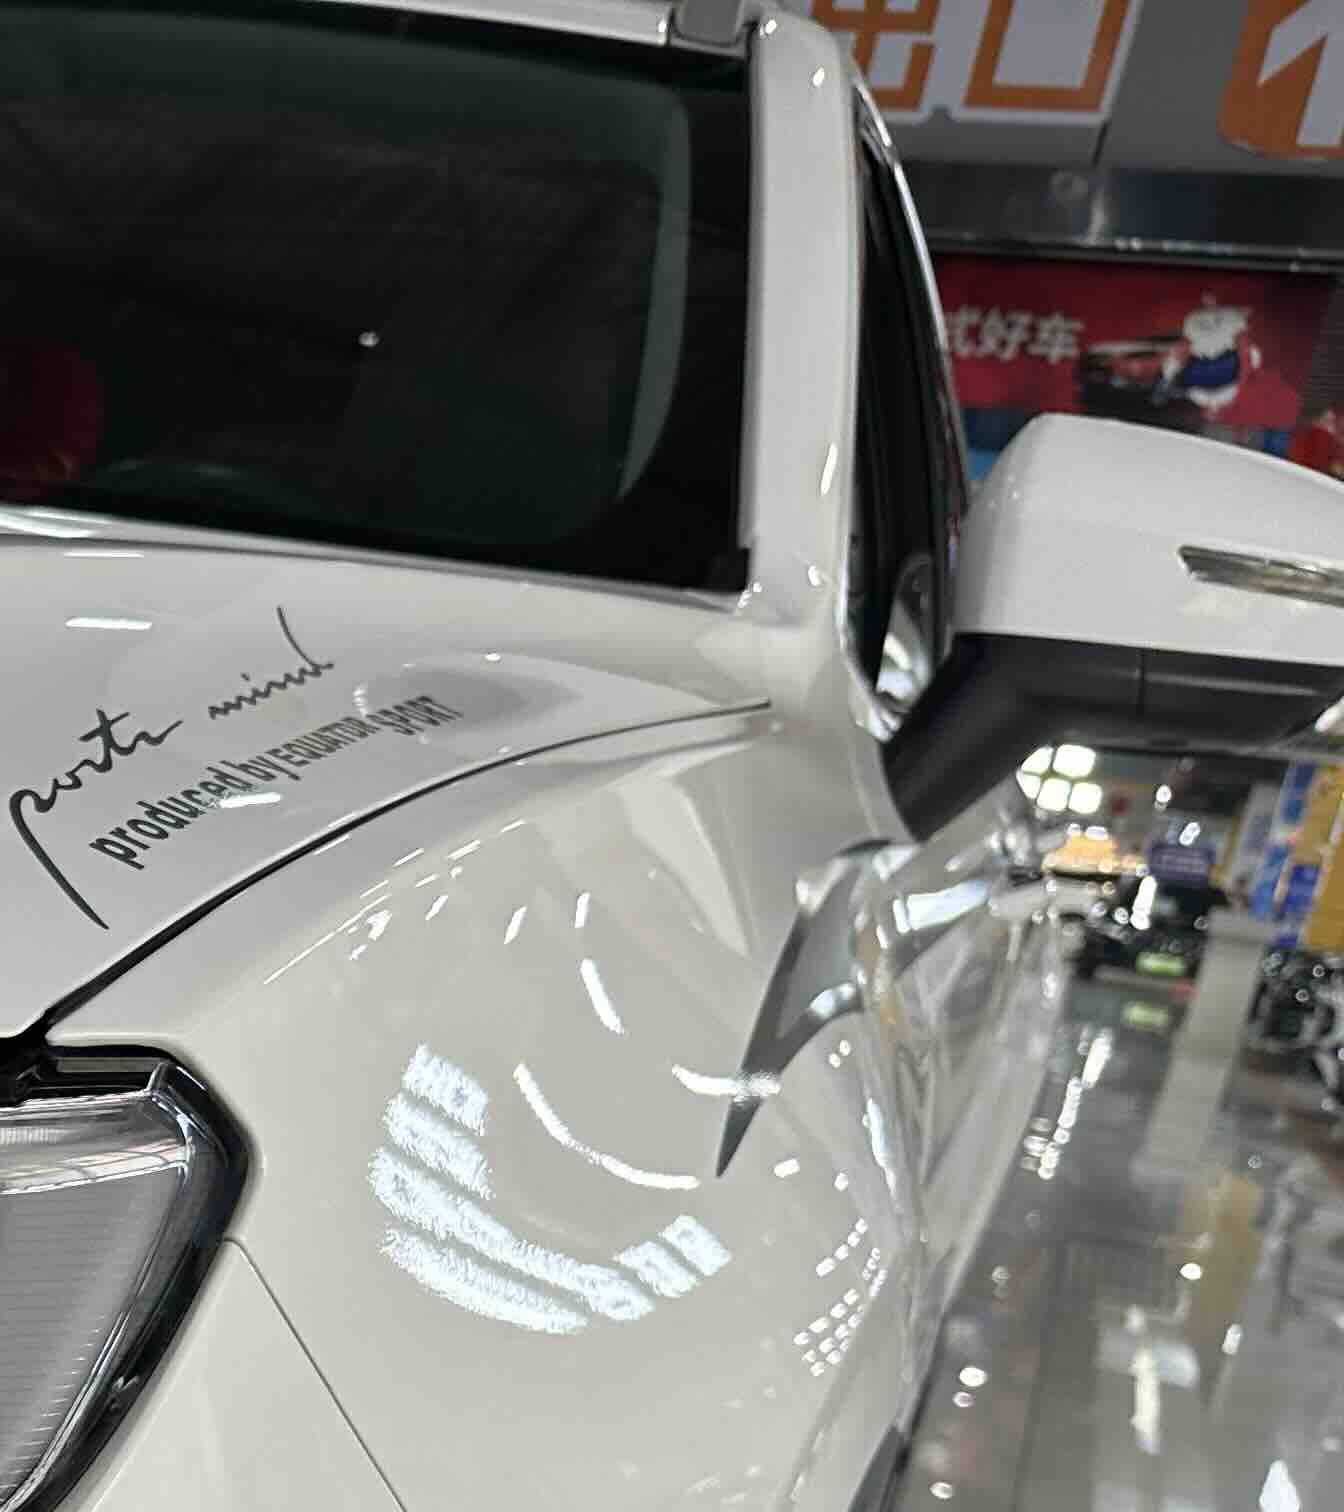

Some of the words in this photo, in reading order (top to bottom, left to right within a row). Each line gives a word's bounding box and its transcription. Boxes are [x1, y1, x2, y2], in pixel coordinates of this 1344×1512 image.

[207, 605, 334, 720] mind
[89, 766, 258, 870] produced
[218, 755, 301, 782] by
[264, 716, 382, 767] EQUATOR
[365, 695, 464, 736] SPORT
